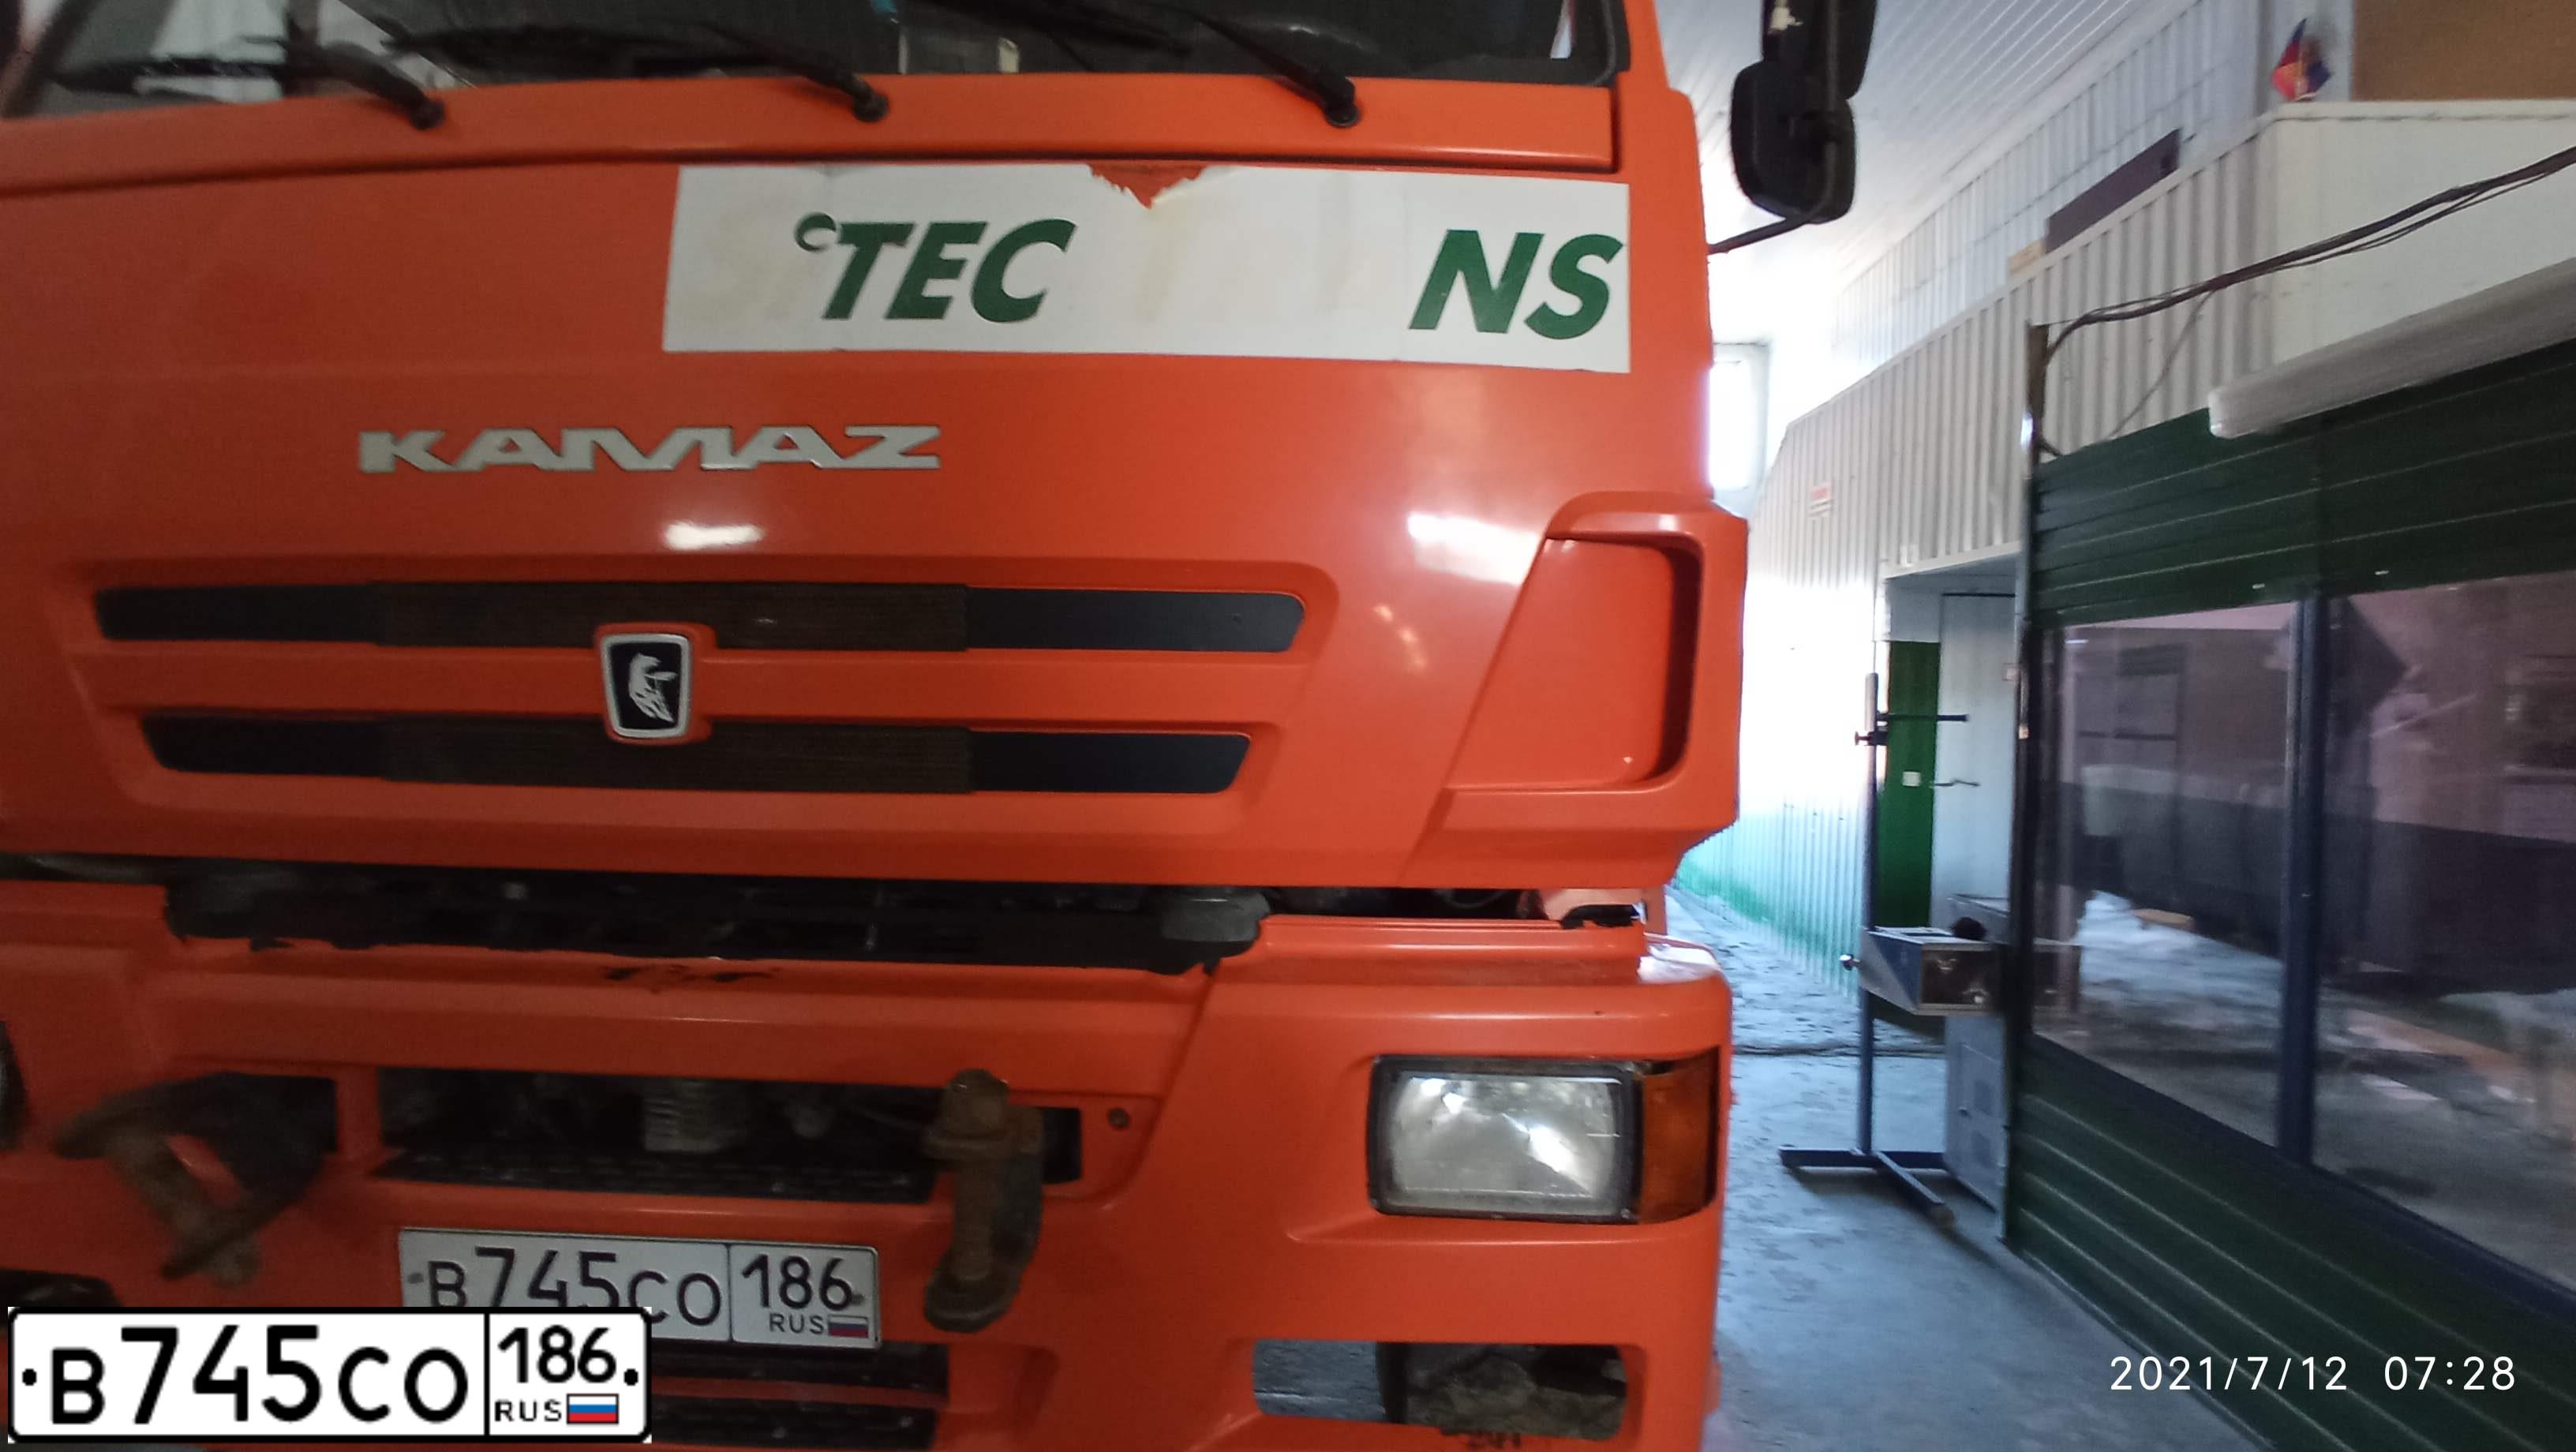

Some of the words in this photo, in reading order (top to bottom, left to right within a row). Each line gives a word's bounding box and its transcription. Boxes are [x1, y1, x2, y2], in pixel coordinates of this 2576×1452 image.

[358, 425, 942, 472] KAMAZ
[739, 1253, 853, 1312] 186
[768, 1313, 826, 1335] RUS
